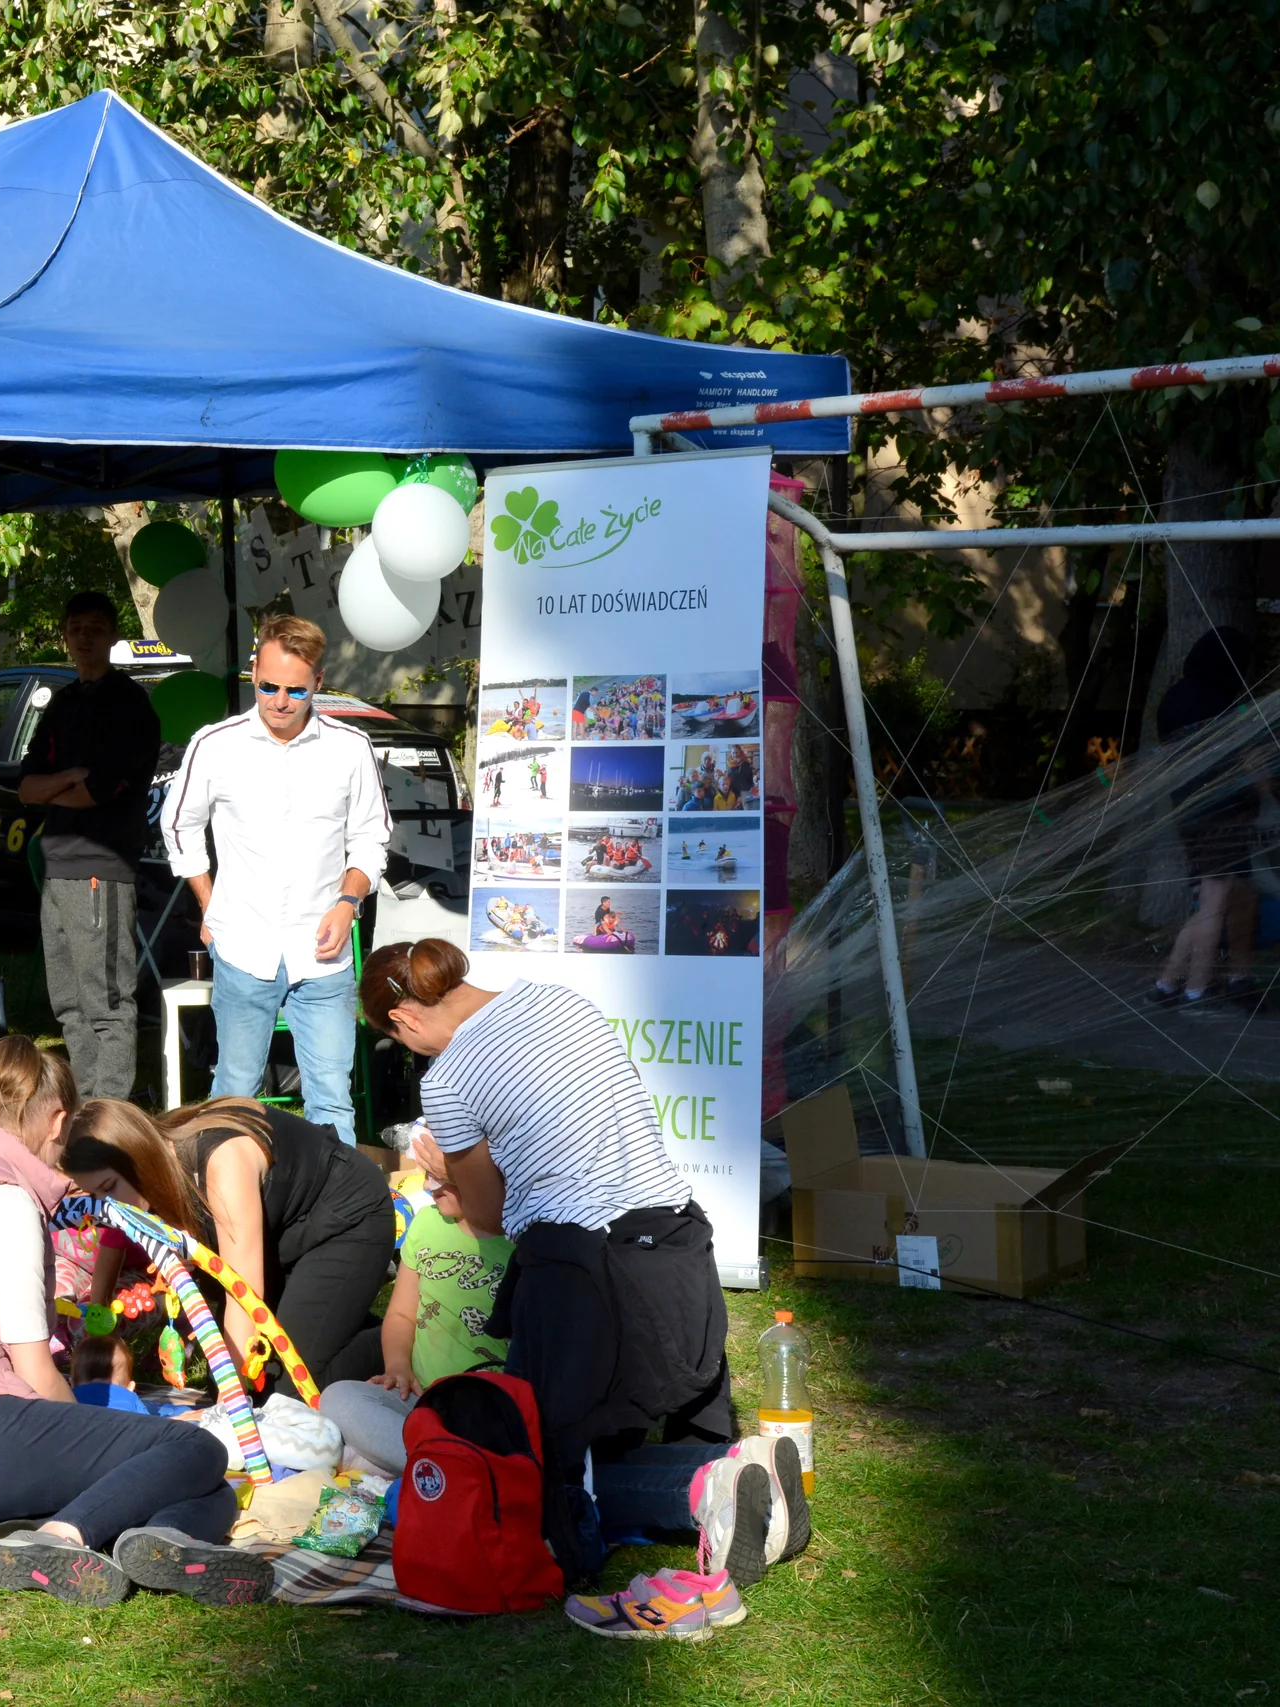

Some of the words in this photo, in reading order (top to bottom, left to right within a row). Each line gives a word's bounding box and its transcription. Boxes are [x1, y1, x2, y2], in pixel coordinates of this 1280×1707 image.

[698, 388, 732, 397] NAMIOTY
[736, 388, 778, 397] HANDLOWE
[600, 496, 663, 545] Życie
[536, 595, 555, 615] 10
[559, 593, 587, 614] LAT
[591, 585, 708, 614] DOŚWIADCZEŃ
